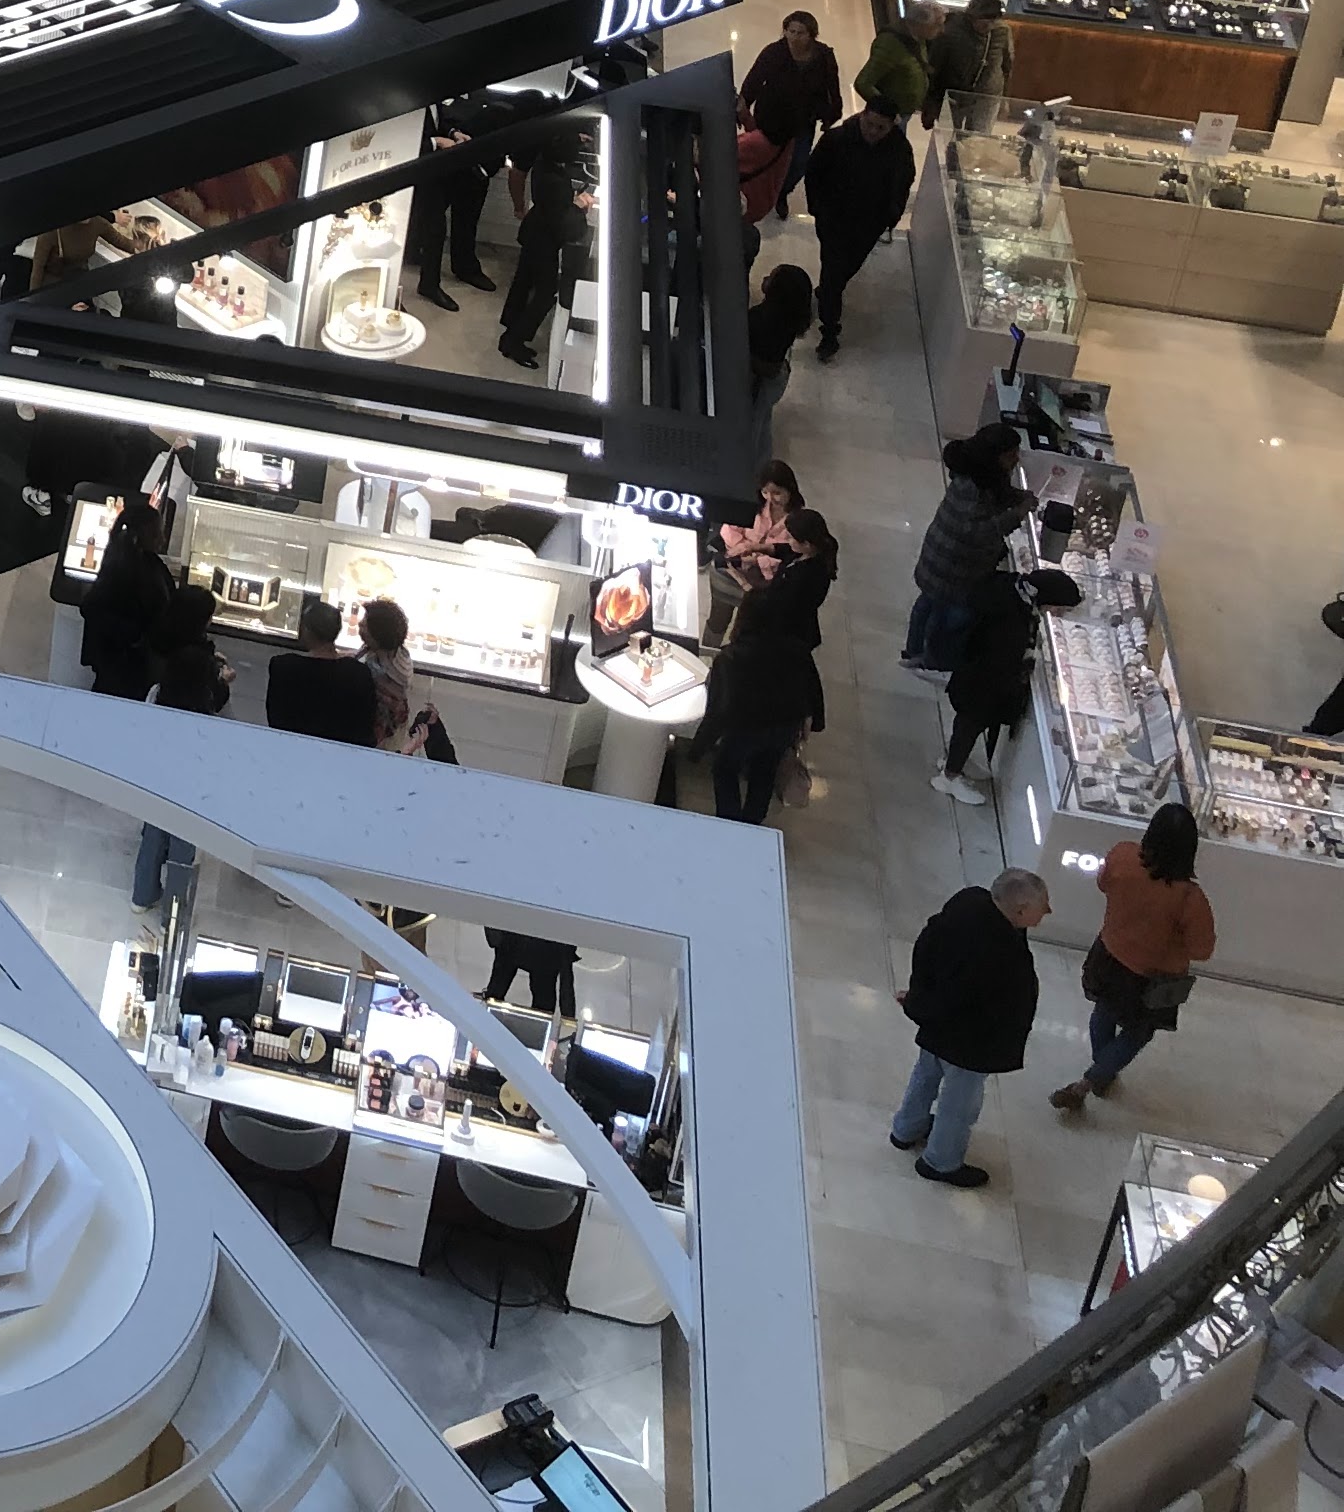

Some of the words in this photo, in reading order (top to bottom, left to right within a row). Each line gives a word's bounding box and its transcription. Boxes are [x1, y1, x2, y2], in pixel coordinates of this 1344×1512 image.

[354, 154, 370, 167] DE
[372, 150, 392, 161] VIE
[615, 482, 704, 520] DIOR
